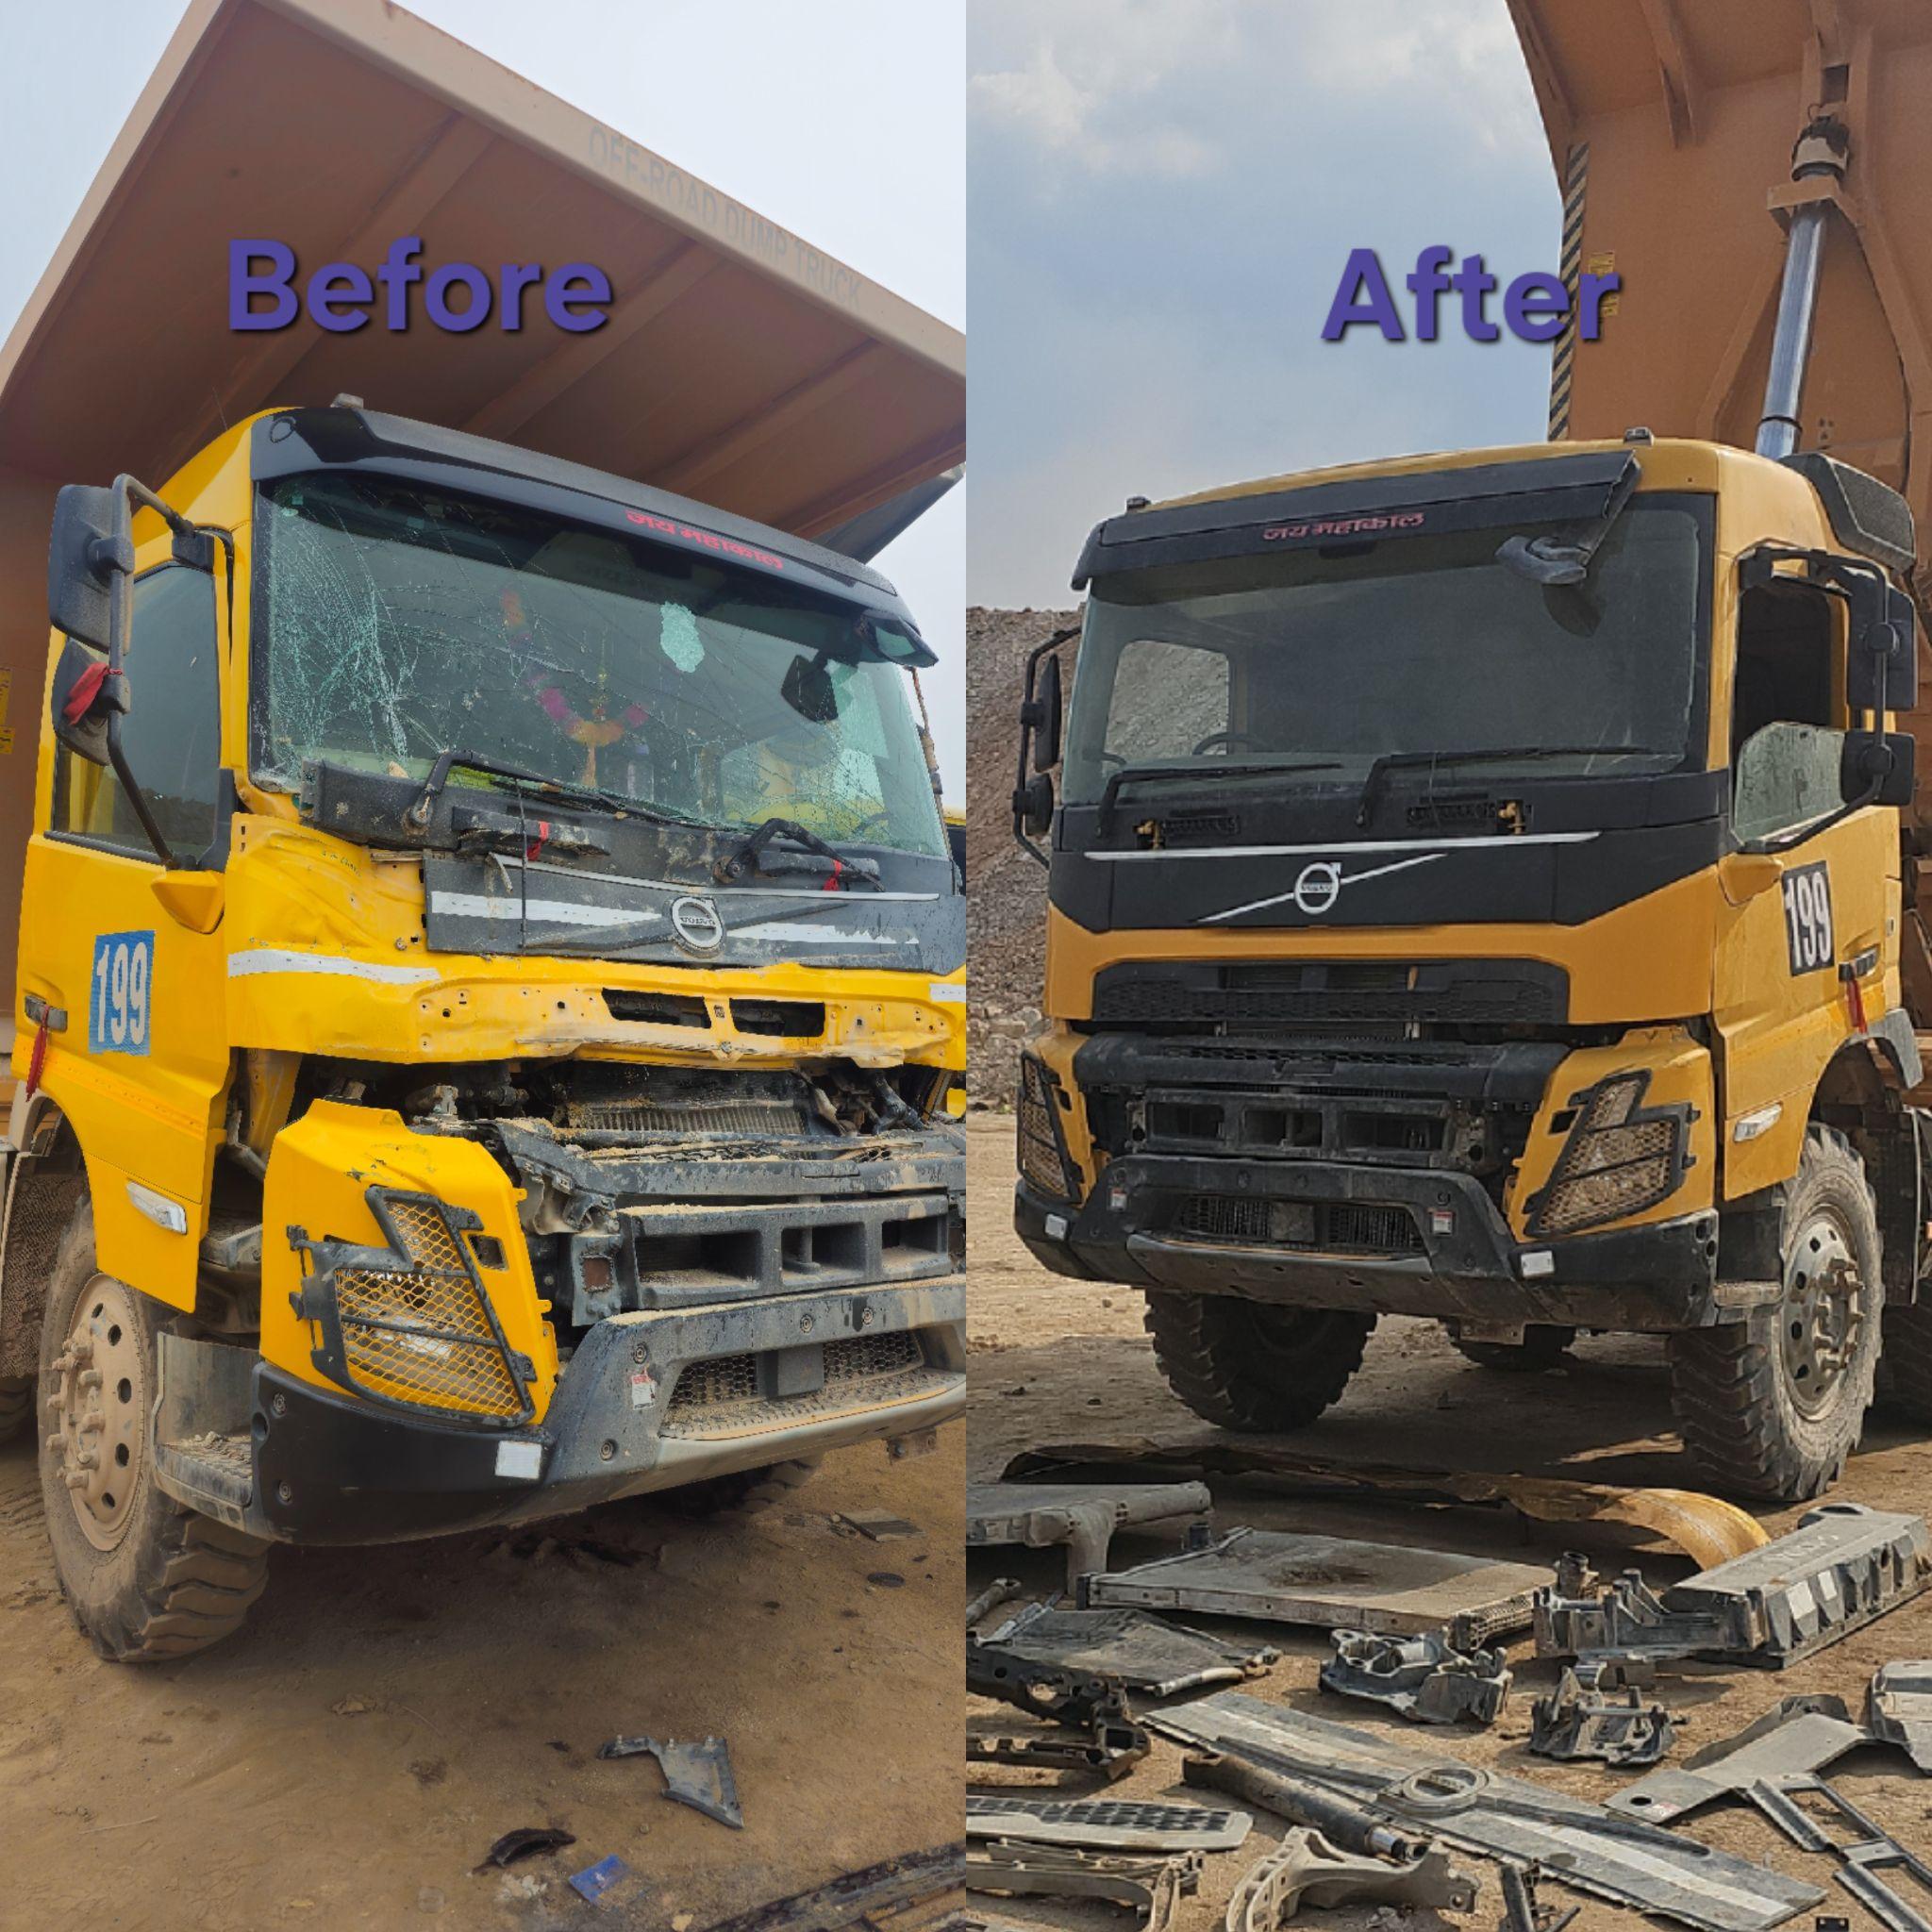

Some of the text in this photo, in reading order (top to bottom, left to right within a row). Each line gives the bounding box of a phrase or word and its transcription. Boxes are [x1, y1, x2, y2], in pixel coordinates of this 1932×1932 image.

[588, 125, 863, 308] OFF-ROAD DUMP TRUCK
[1785, 871, 1831, 968] 199
[96, 941, 147, 1045] 199
